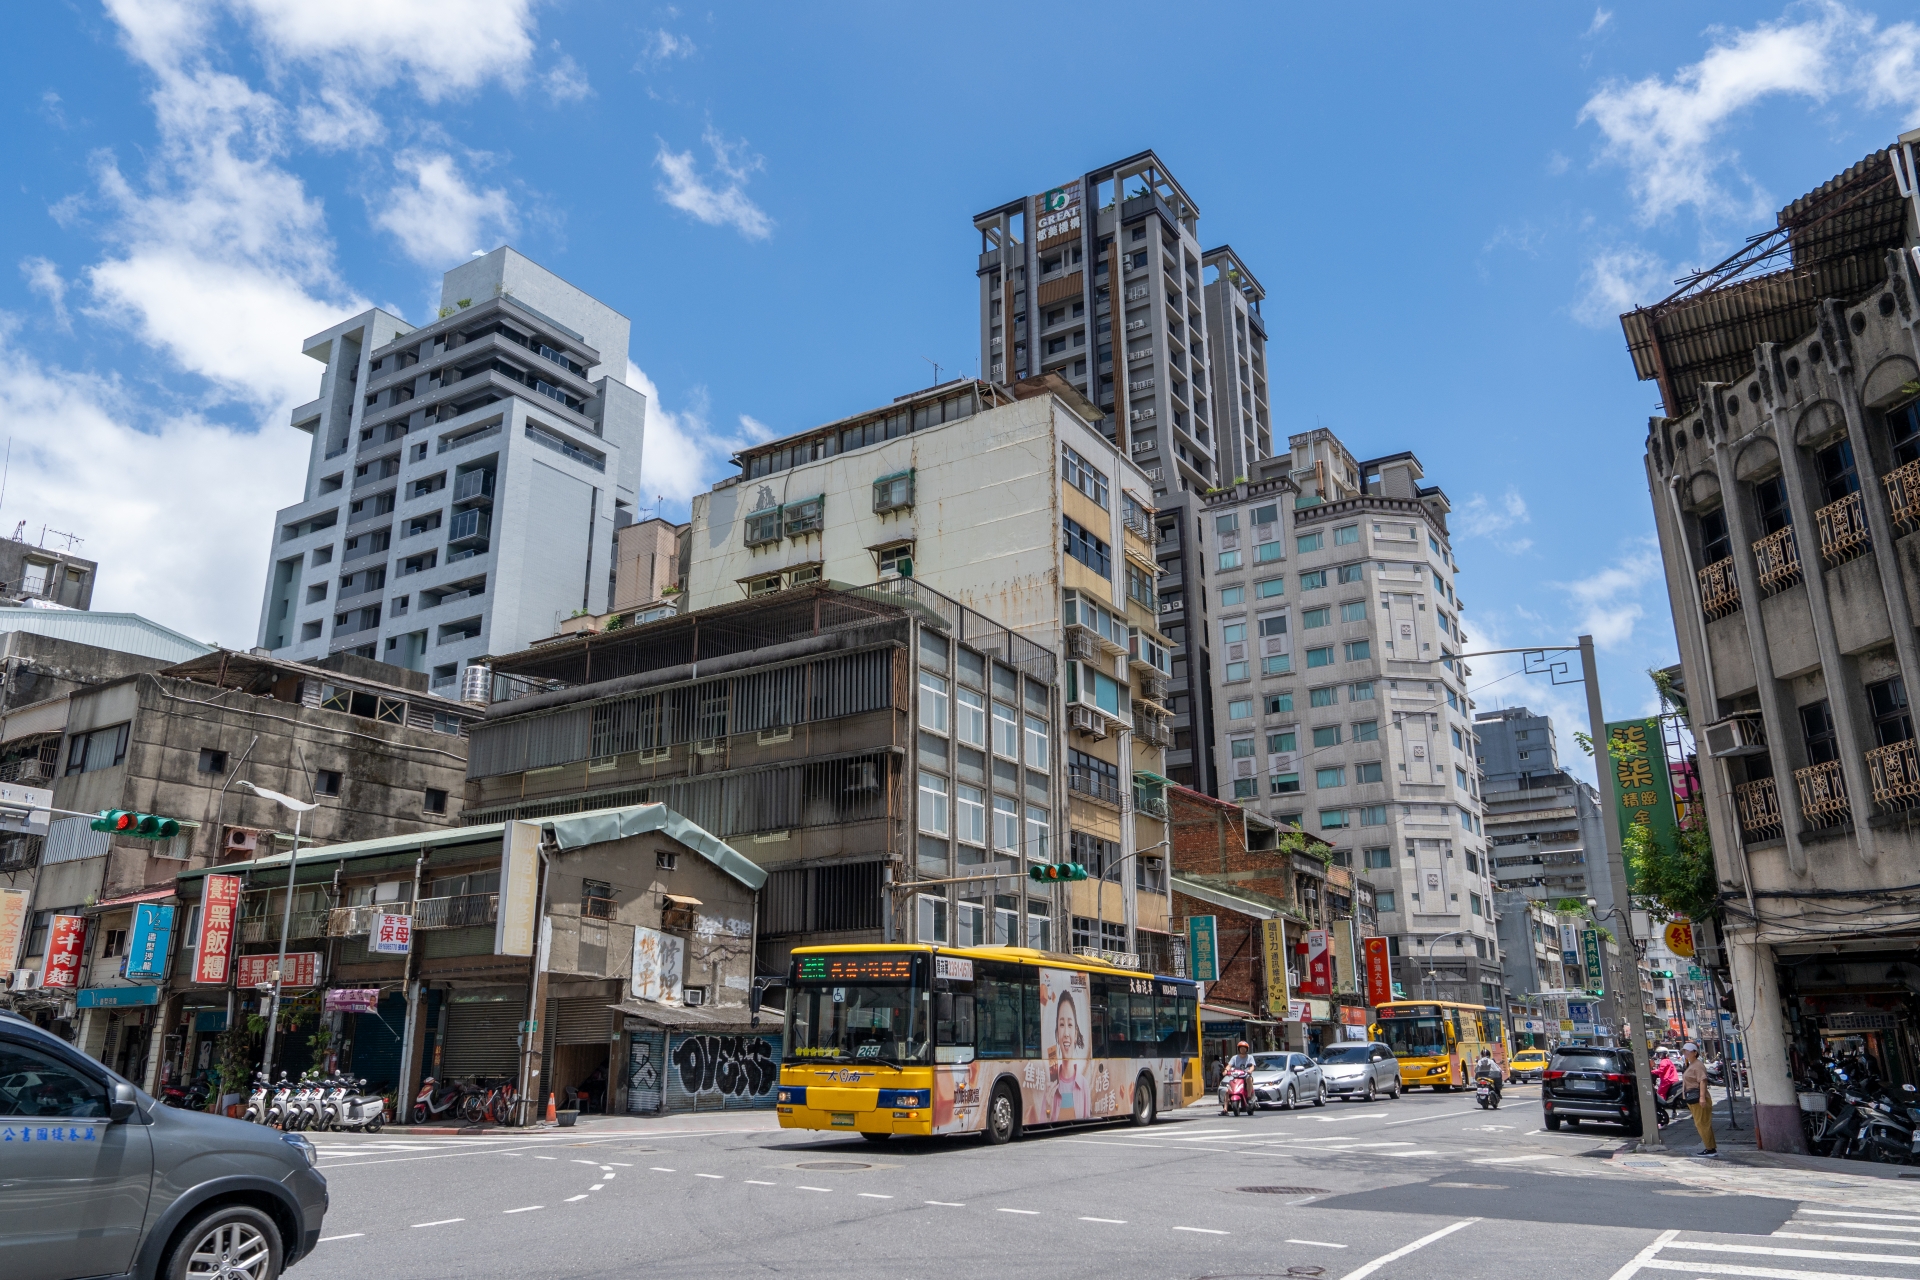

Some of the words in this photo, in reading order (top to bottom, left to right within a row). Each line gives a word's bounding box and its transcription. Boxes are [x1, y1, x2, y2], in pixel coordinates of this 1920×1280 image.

[1038, 206, 1078, 228] GREAT
[209, 878, 237, 900] 養生
[384, 916, 407, 925] 在宅
[202, 905, 231, 979] 黑飯糰
[380, 926, 409, 943] 保母
[46, 932, 80, 986] 牛肉麵
[1585, 931, 1600, 976] 安興診所
[1129, 978, 1153, 995] 大南汽車
[1373, 957, 1384, 995] 台灣大哥大
[859, 1046, 879, 1057] 265
[1022, 1062, 1046, 1091] 焦糖
